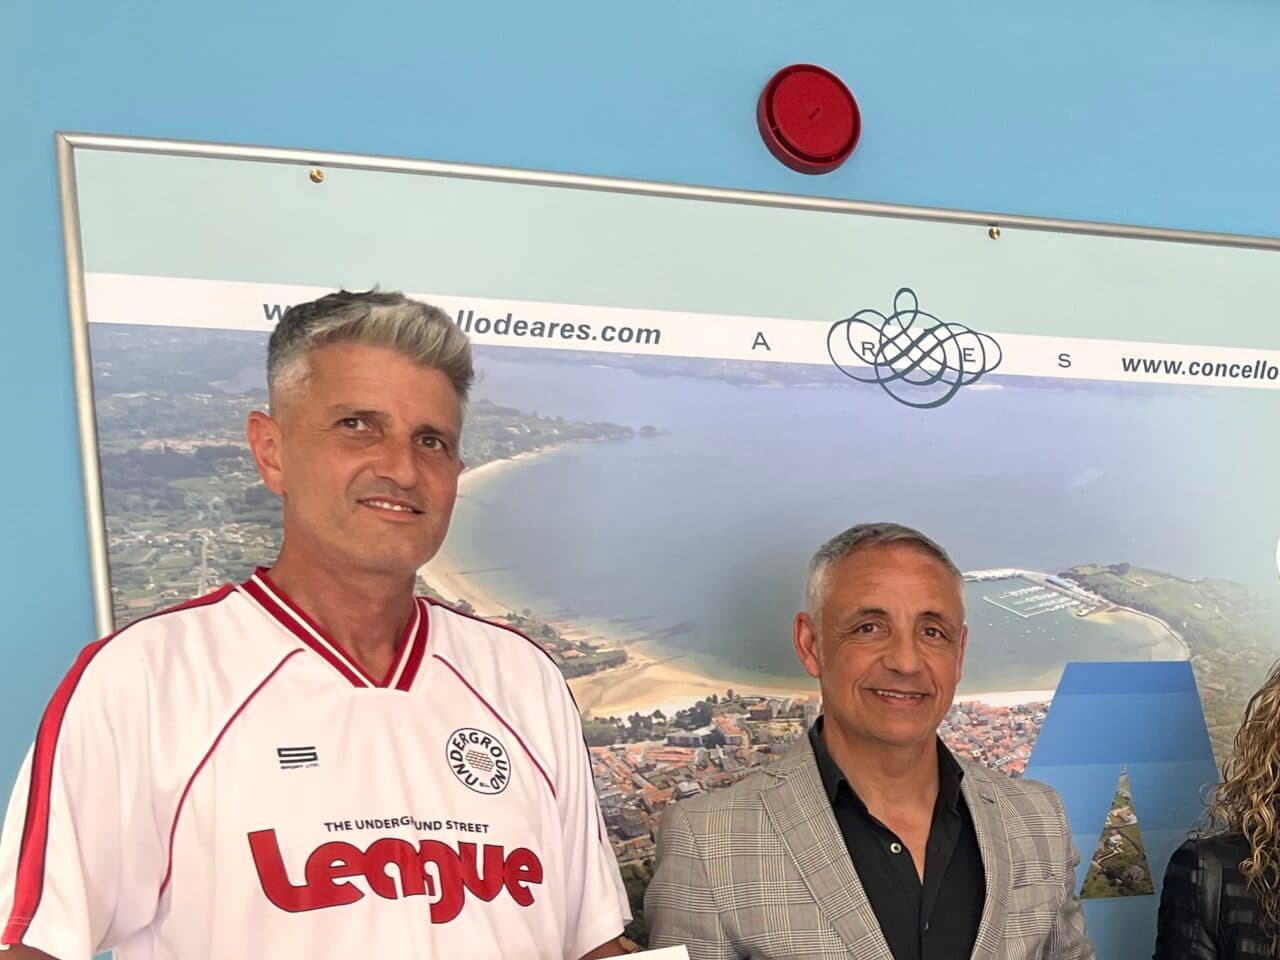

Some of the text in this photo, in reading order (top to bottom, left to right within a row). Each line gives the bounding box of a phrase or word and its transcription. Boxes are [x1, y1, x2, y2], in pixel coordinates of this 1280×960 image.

[263, 302, 662, 345] wllodeares.com
[324, 816, 490, 834] THE UNDERGUND STREET
